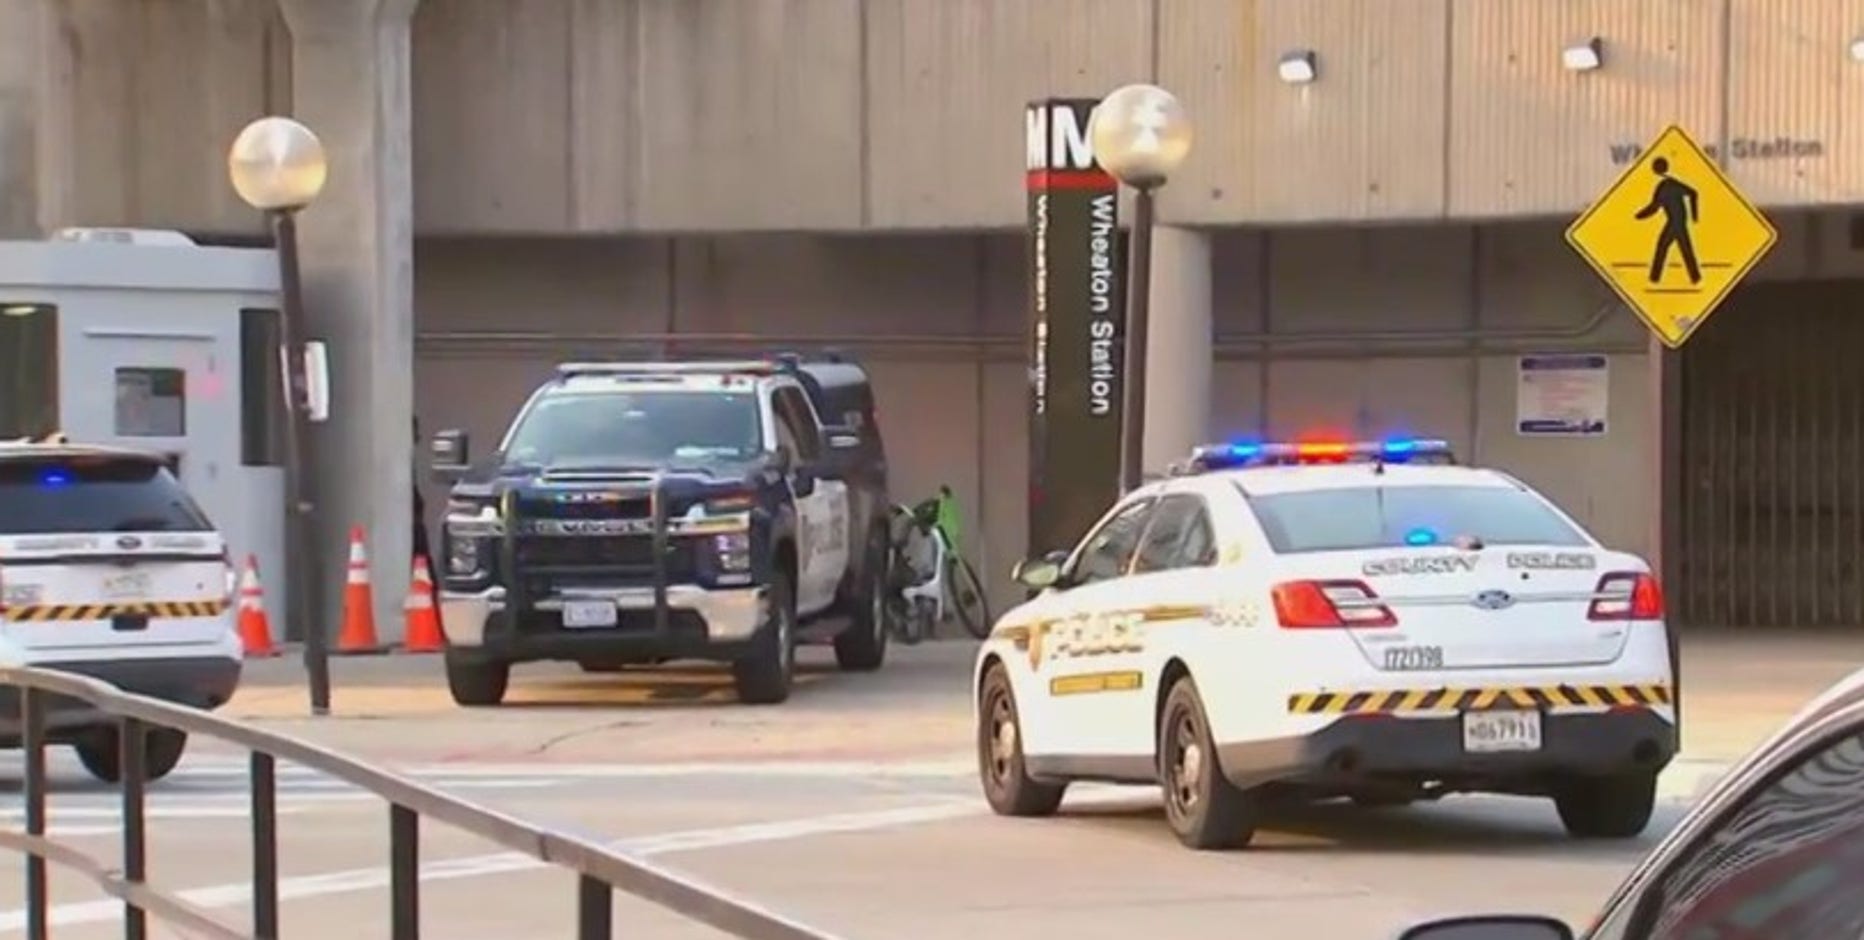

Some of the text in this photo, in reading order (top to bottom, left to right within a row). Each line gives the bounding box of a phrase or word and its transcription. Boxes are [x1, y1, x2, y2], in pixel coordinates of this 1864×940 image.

[1731, 137, 1823, 160] Station
[1090, 194, 1114, 415] Wheaton Station
